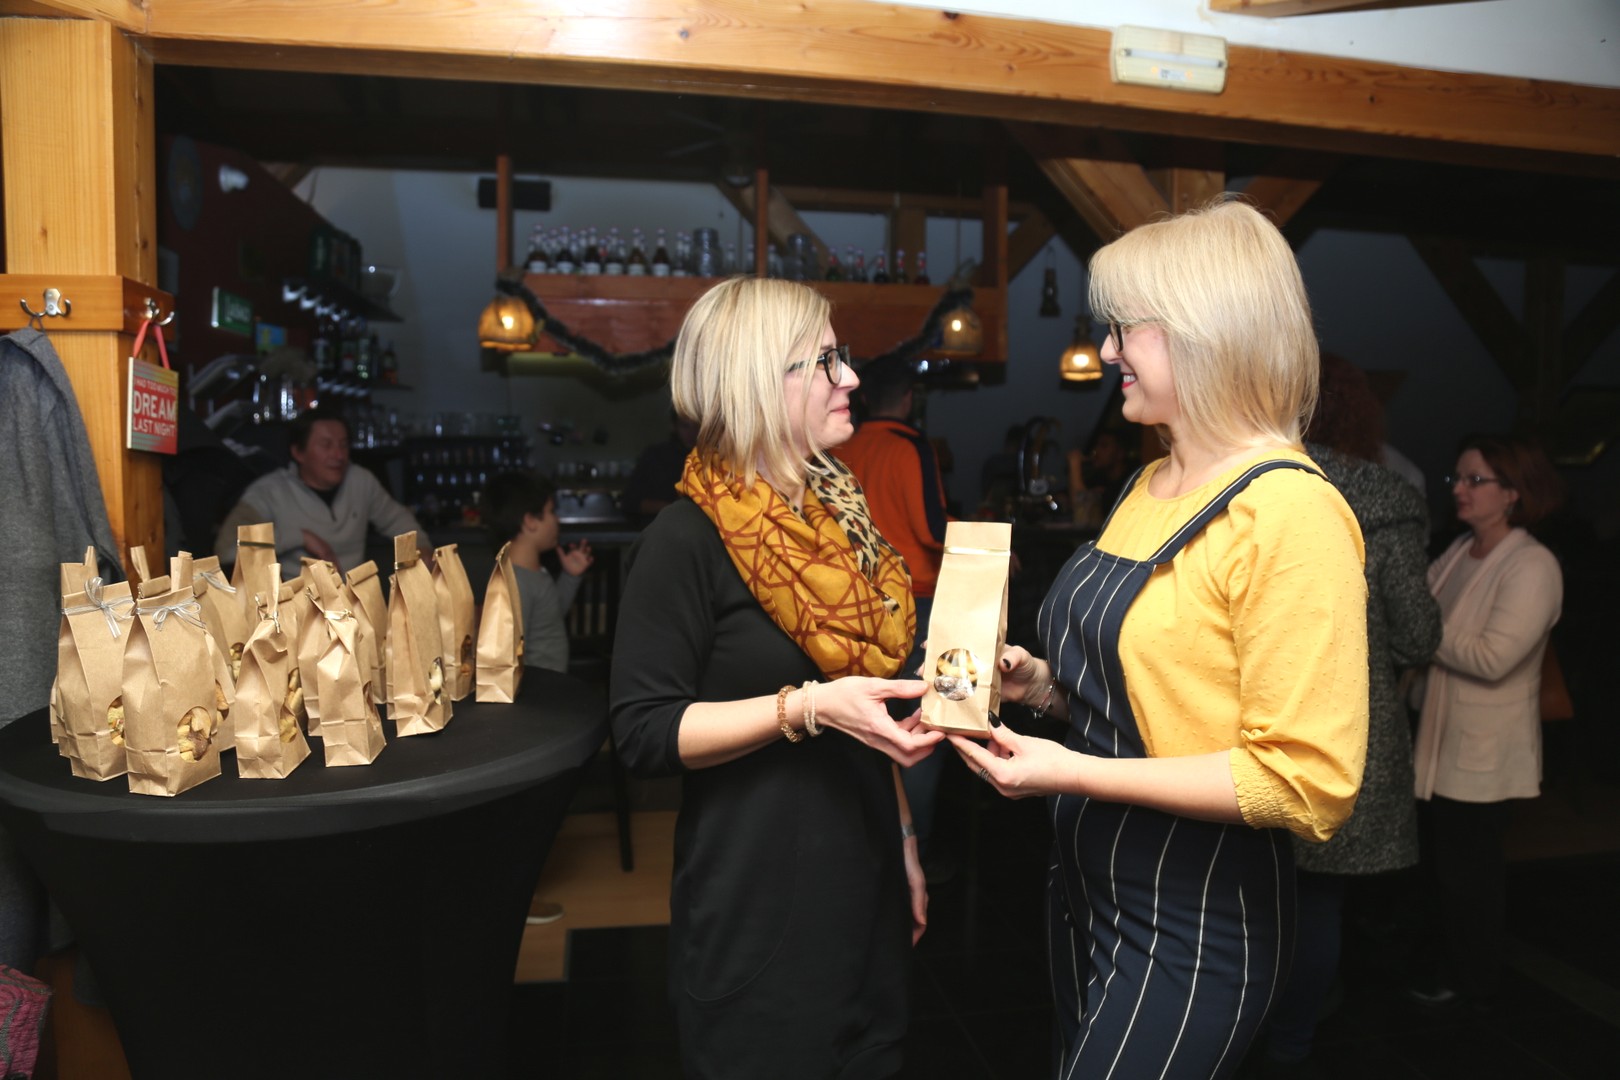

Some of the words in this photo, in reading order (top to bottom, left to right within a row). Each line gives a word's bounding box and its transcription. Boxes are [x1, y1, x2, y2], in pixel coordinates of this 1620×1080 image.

[134, 391, 176, 421] DREAM
[133, 417, 153, 433] LAST
[154, 421, 175, 437] NIGHT
